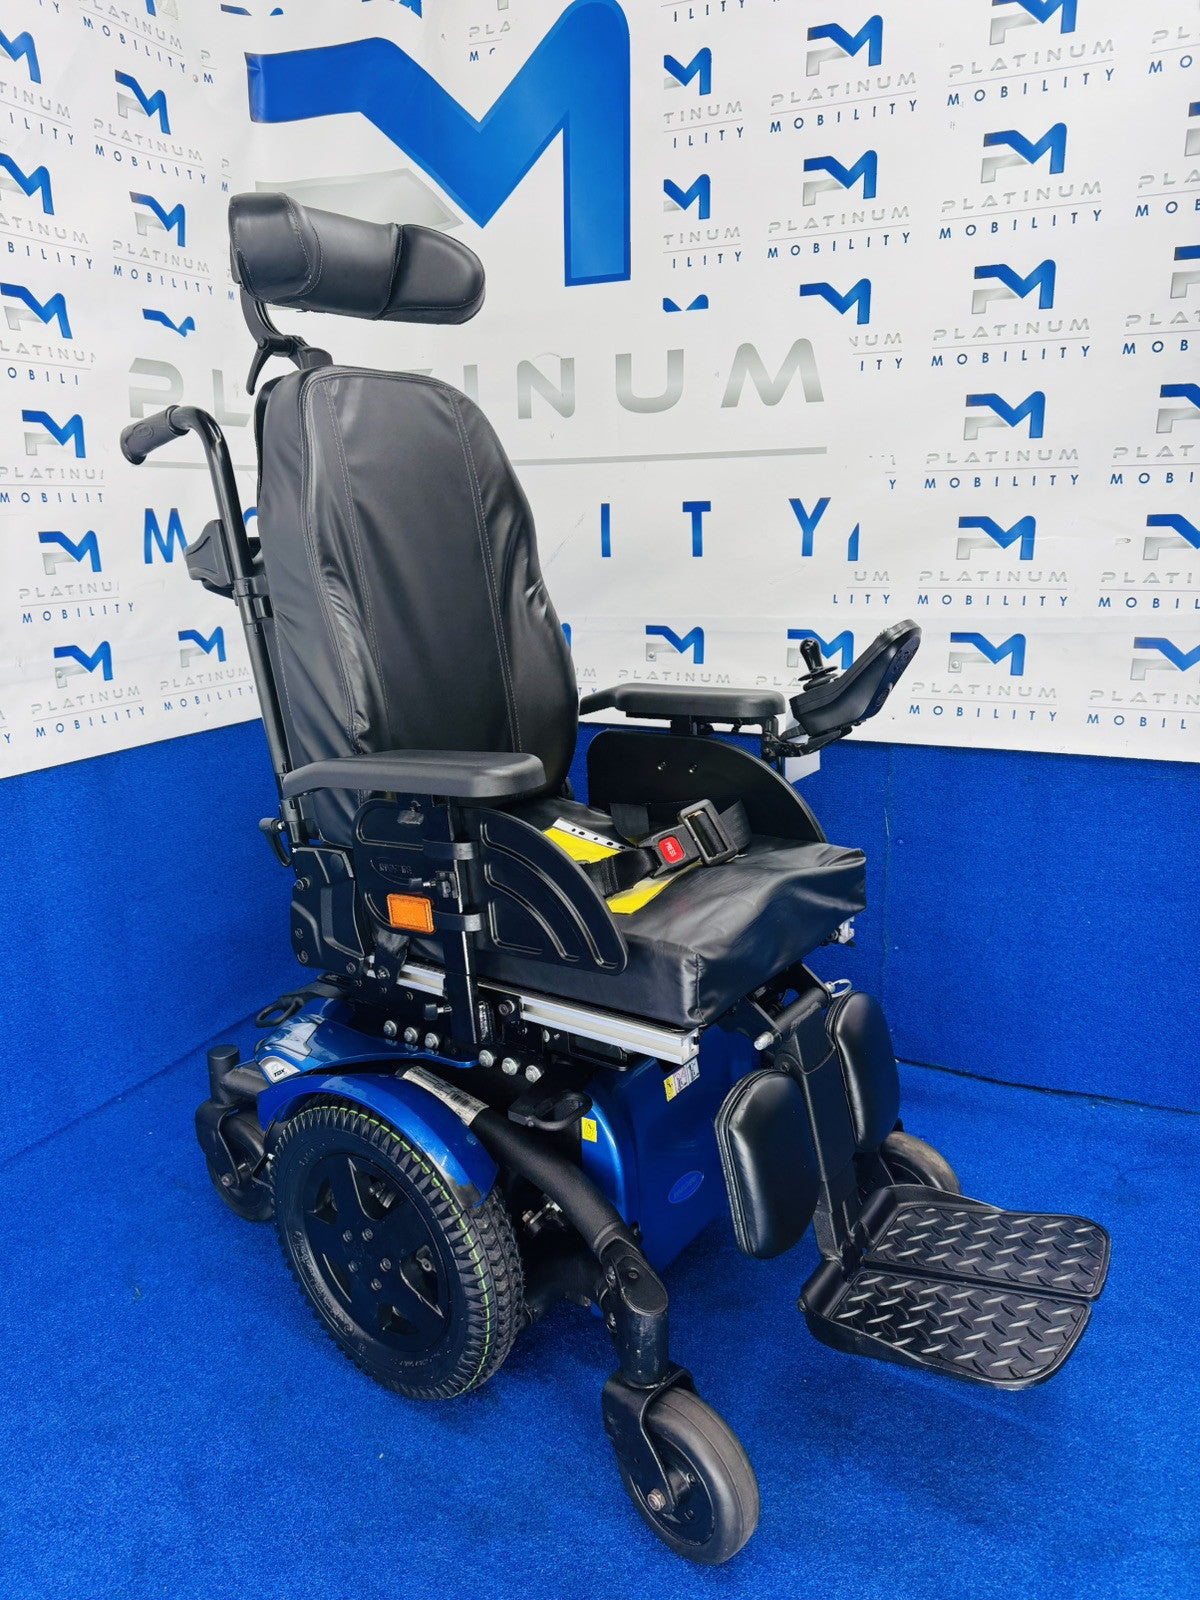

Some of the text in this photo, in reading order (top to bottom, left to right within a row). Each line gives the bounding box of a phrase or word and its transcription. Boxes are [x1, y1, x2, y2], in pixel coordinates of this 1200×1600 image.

[79, 0, 183, 50] LATINUM
[83, 16, 186, 73] MOBILITY
[948, 39, 1115, 78] PLATINUM
[770, 72, 917, 107] PLATINUM
[946, 68, 1115, 107] MOBILITY
[769, 99, 917, 133] MOBILITY
[93, 118, 203, 162] PLATINUM
[95, 143, 207, 184] MOBILITY
[941, 180, 1102, 213] PLATINUM
[768, 205, 910, 234] PLATINUM
[938, 209, 1102, 240] MOBILITY
[112, 240, 210, 273] PLATINUM
[767, 232, 911, 259] MOBILITY
[113, 265, 214, 295] MOBILITY
[932, 318, 1091, 342] PLATINUM
[931, 345, 1091, 367] MOBILITY
[926, 448, 1080, 465] PLATINUM
[924, 474, 1080, 489] MOBILITY
[19, 581, 120, 600] PLATINU
[918, 569, 1069, 583] PLATINUM
[22, 602, 135, 624] MOBILITY
[917, 594, 1069, 606] MOBILITY
[618, 669, 731, 685] PLATINUM
[911, 682, 1058, 699] PLATINUM
[31, 685, 141, 715] PLATINUM
[163, 684, 255, 712] MOBILITY
[36, 706, 146, 738] MOBILITY
[908, 704, 1058, 722] MOBILITY
